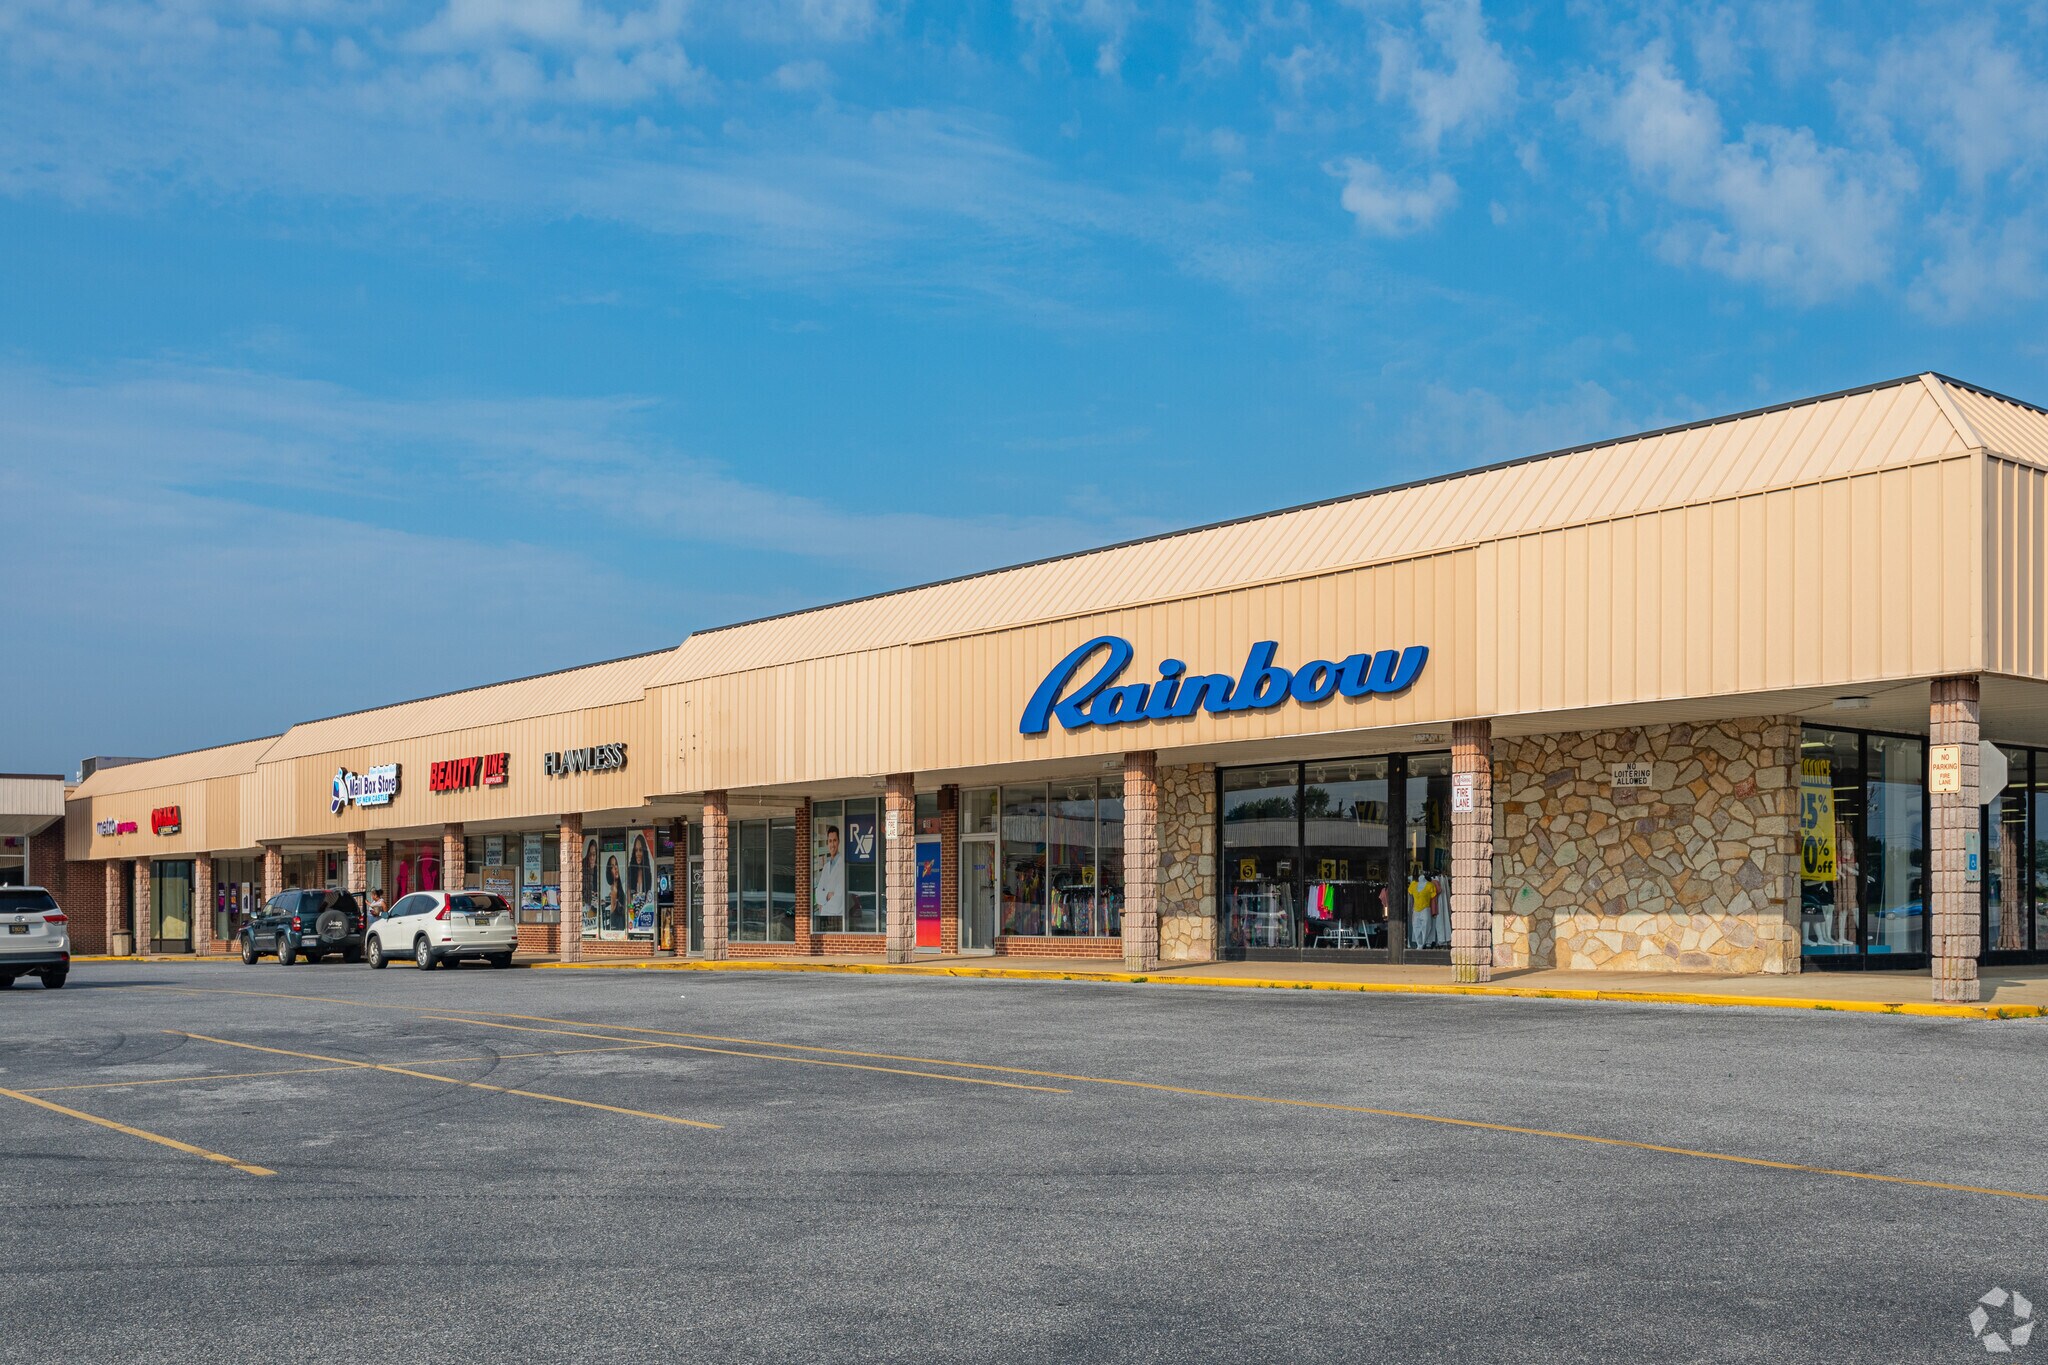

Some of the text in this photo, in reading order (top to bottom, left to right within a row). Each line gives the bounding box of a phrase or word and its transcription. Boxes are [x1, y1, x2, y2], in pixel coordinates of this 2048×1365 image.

[1019, 635, 1429, 733] Rainbow
[544, 742, 623, 775] FLAWLESS
[429, 752, 505, 791] BEAUTY LINE
[1614, 770, 1650, 778] LOITERING
[349, 774, 396, 797] Mail Box Store
[1616, 777, 1648, 785] ALLOWED
[372, 794, 388, 802] CASTLE
[1457, 788, 1468, 797] FIRE
[1456, 798, 1469, 807] LANE
[96, 817, 116, 835] metro
[1817, 861, 1833, 873] off
